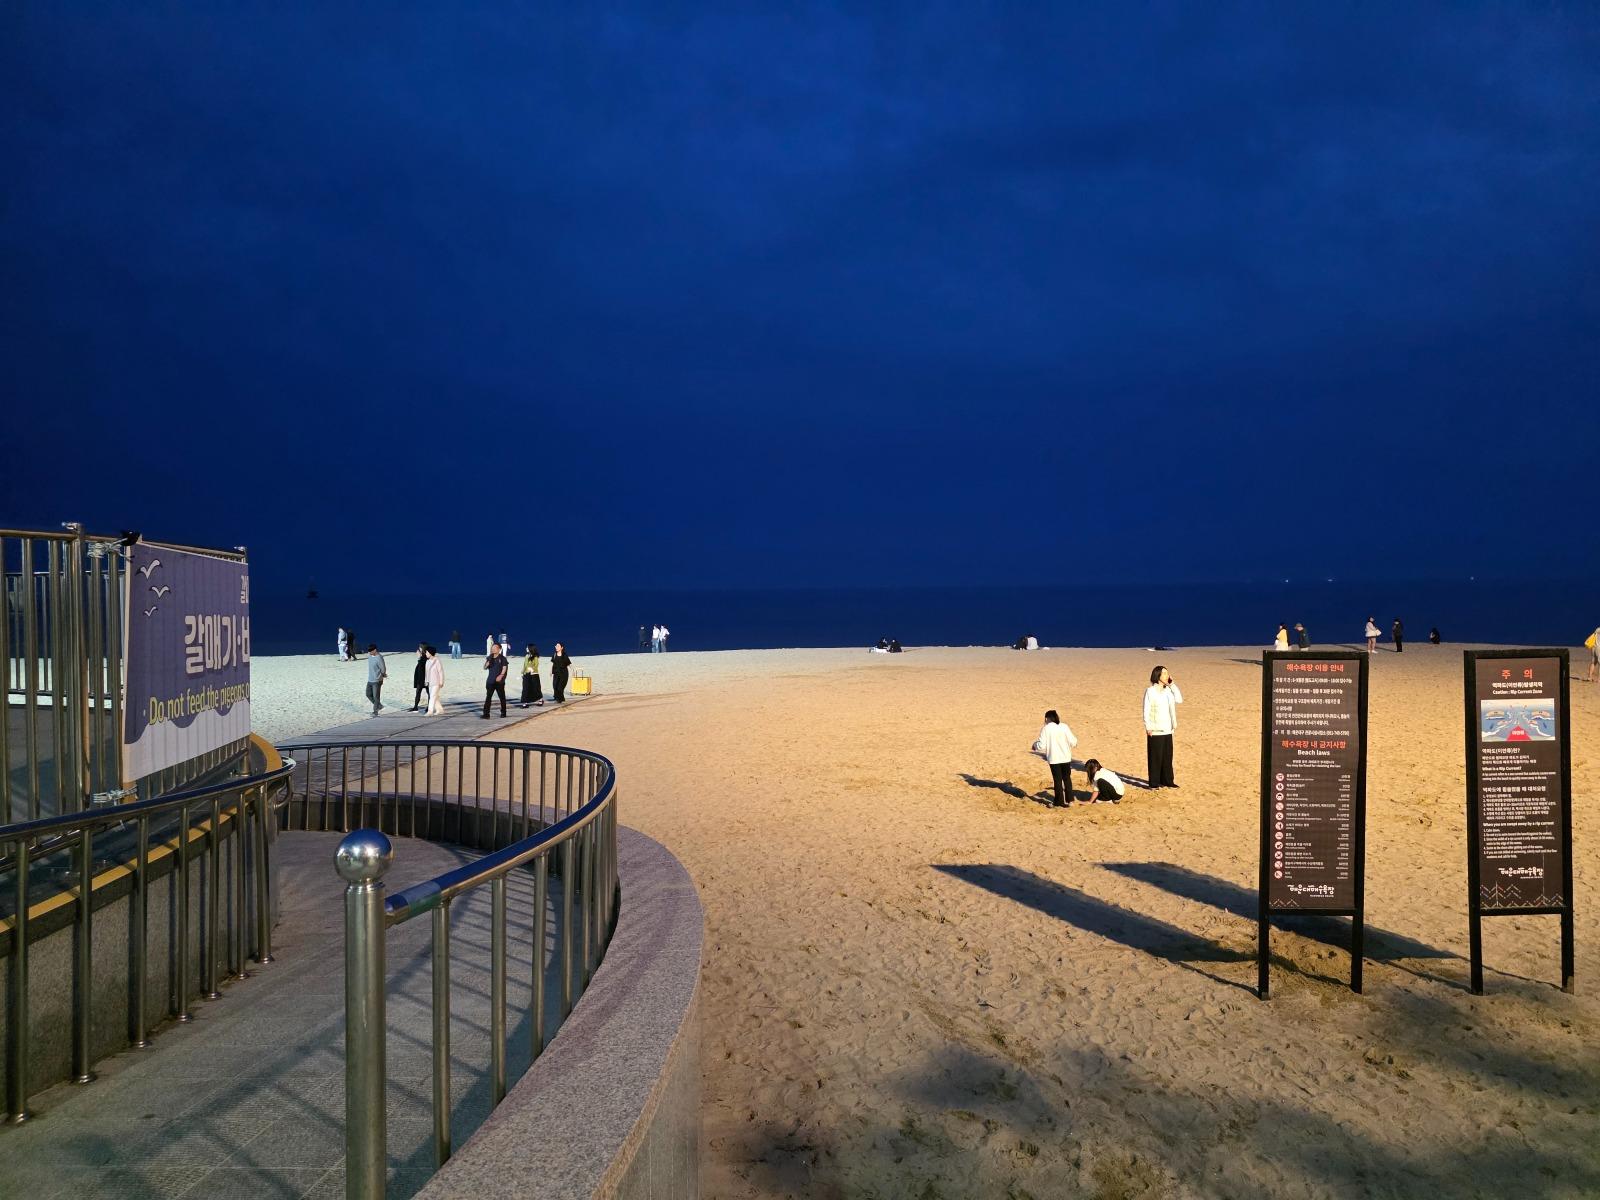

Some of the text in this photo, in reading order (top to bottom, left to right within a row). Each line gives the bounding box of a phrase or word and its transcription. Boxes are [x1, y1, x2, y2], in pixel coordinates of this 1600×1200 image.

[1286, 664, 1313, 672] 해수욕장
[1330, 664, 1344, 672] 안내
[1502, 668, 1532, 680] 주 의
[150, 696, 165, 725] Do
[167, 692, 184, 720] not
[187, 685, 206, 715] feed
[206, 685, 219, 710] the
[220, 682, 245, 711] pigeons
[1282, 740, 1309, 748] 해수욕장
[1319, 740, 1346, 748] 금지사항
[1287, 884, 1335, 894] 해운대해수욕장
